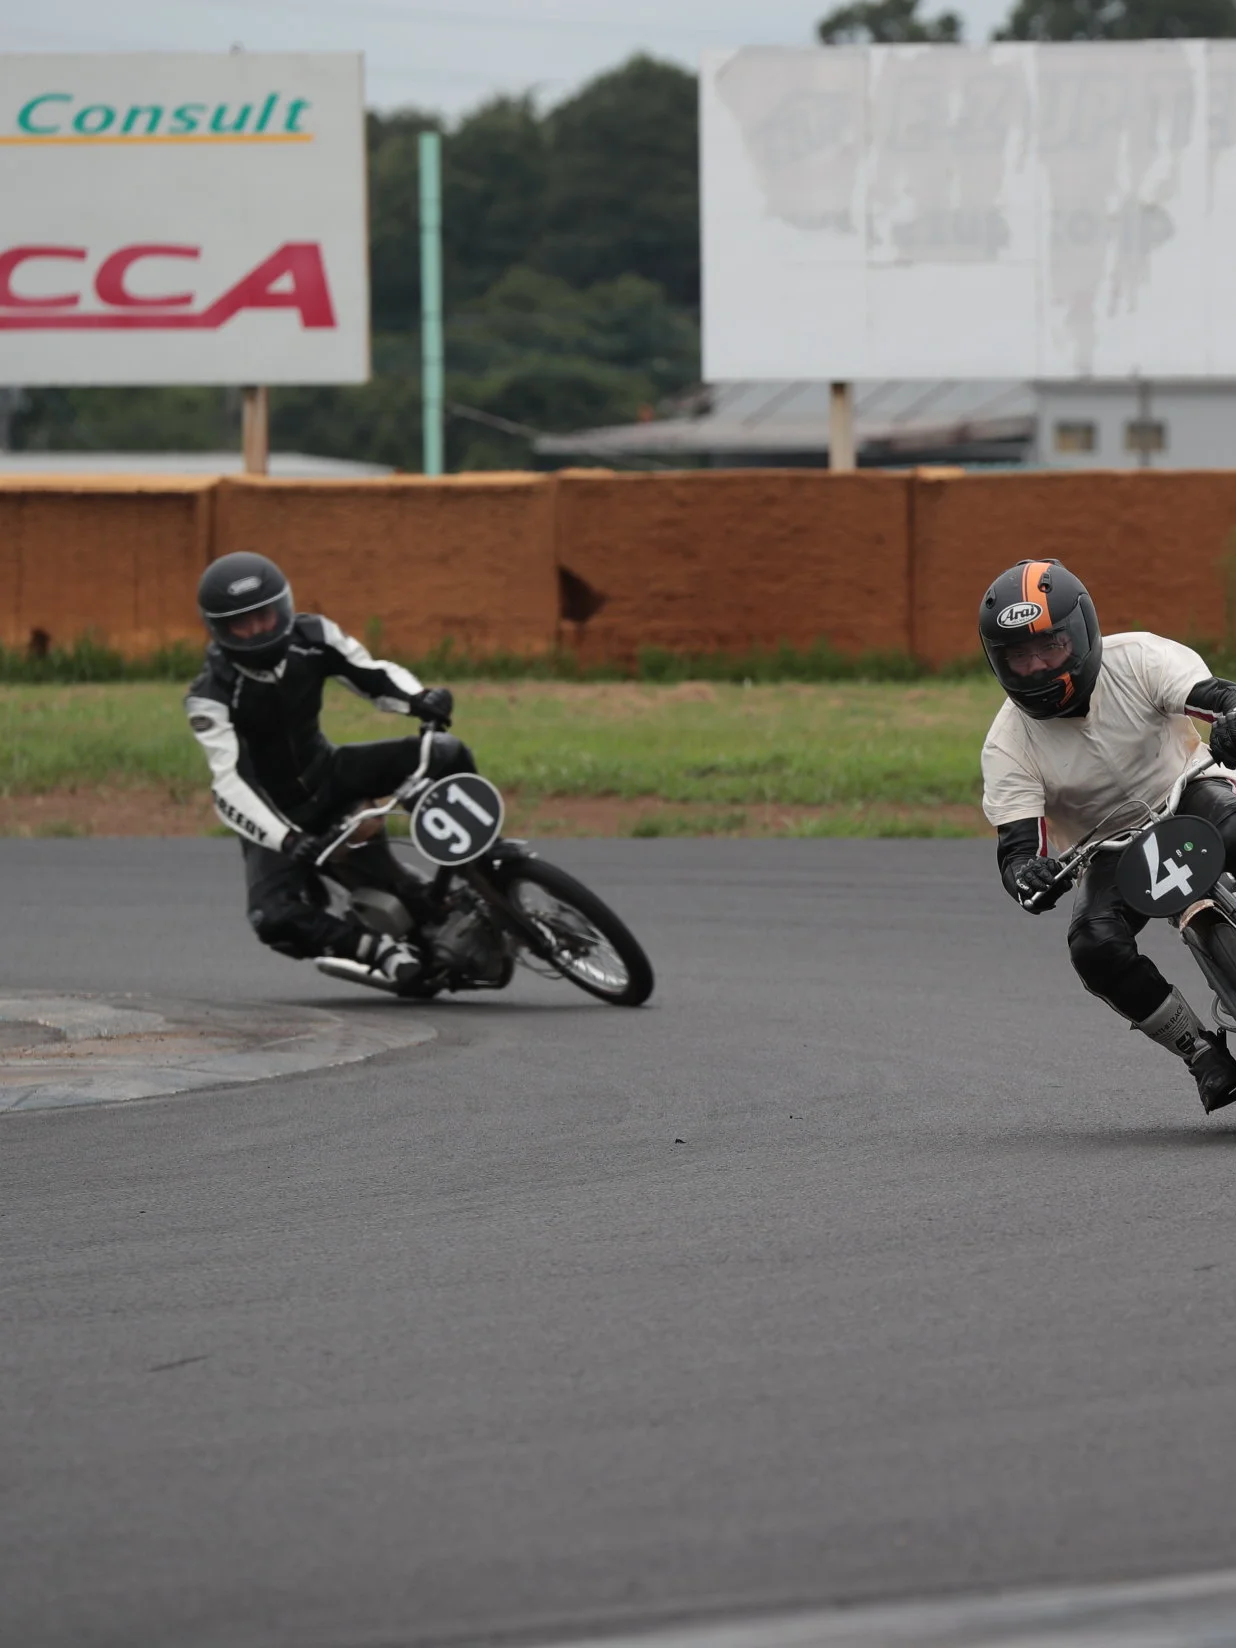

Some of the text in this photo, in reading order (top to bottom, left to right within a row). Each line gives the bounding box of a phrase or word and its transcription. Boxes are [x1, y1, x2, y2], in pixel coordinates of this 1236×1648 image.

[16, 91, 311, 135] Consult
[1001, 604, 1035, 624] Arai
[422, 783, 495, 854] 91
[1142, 831, 1193, 901] 4
